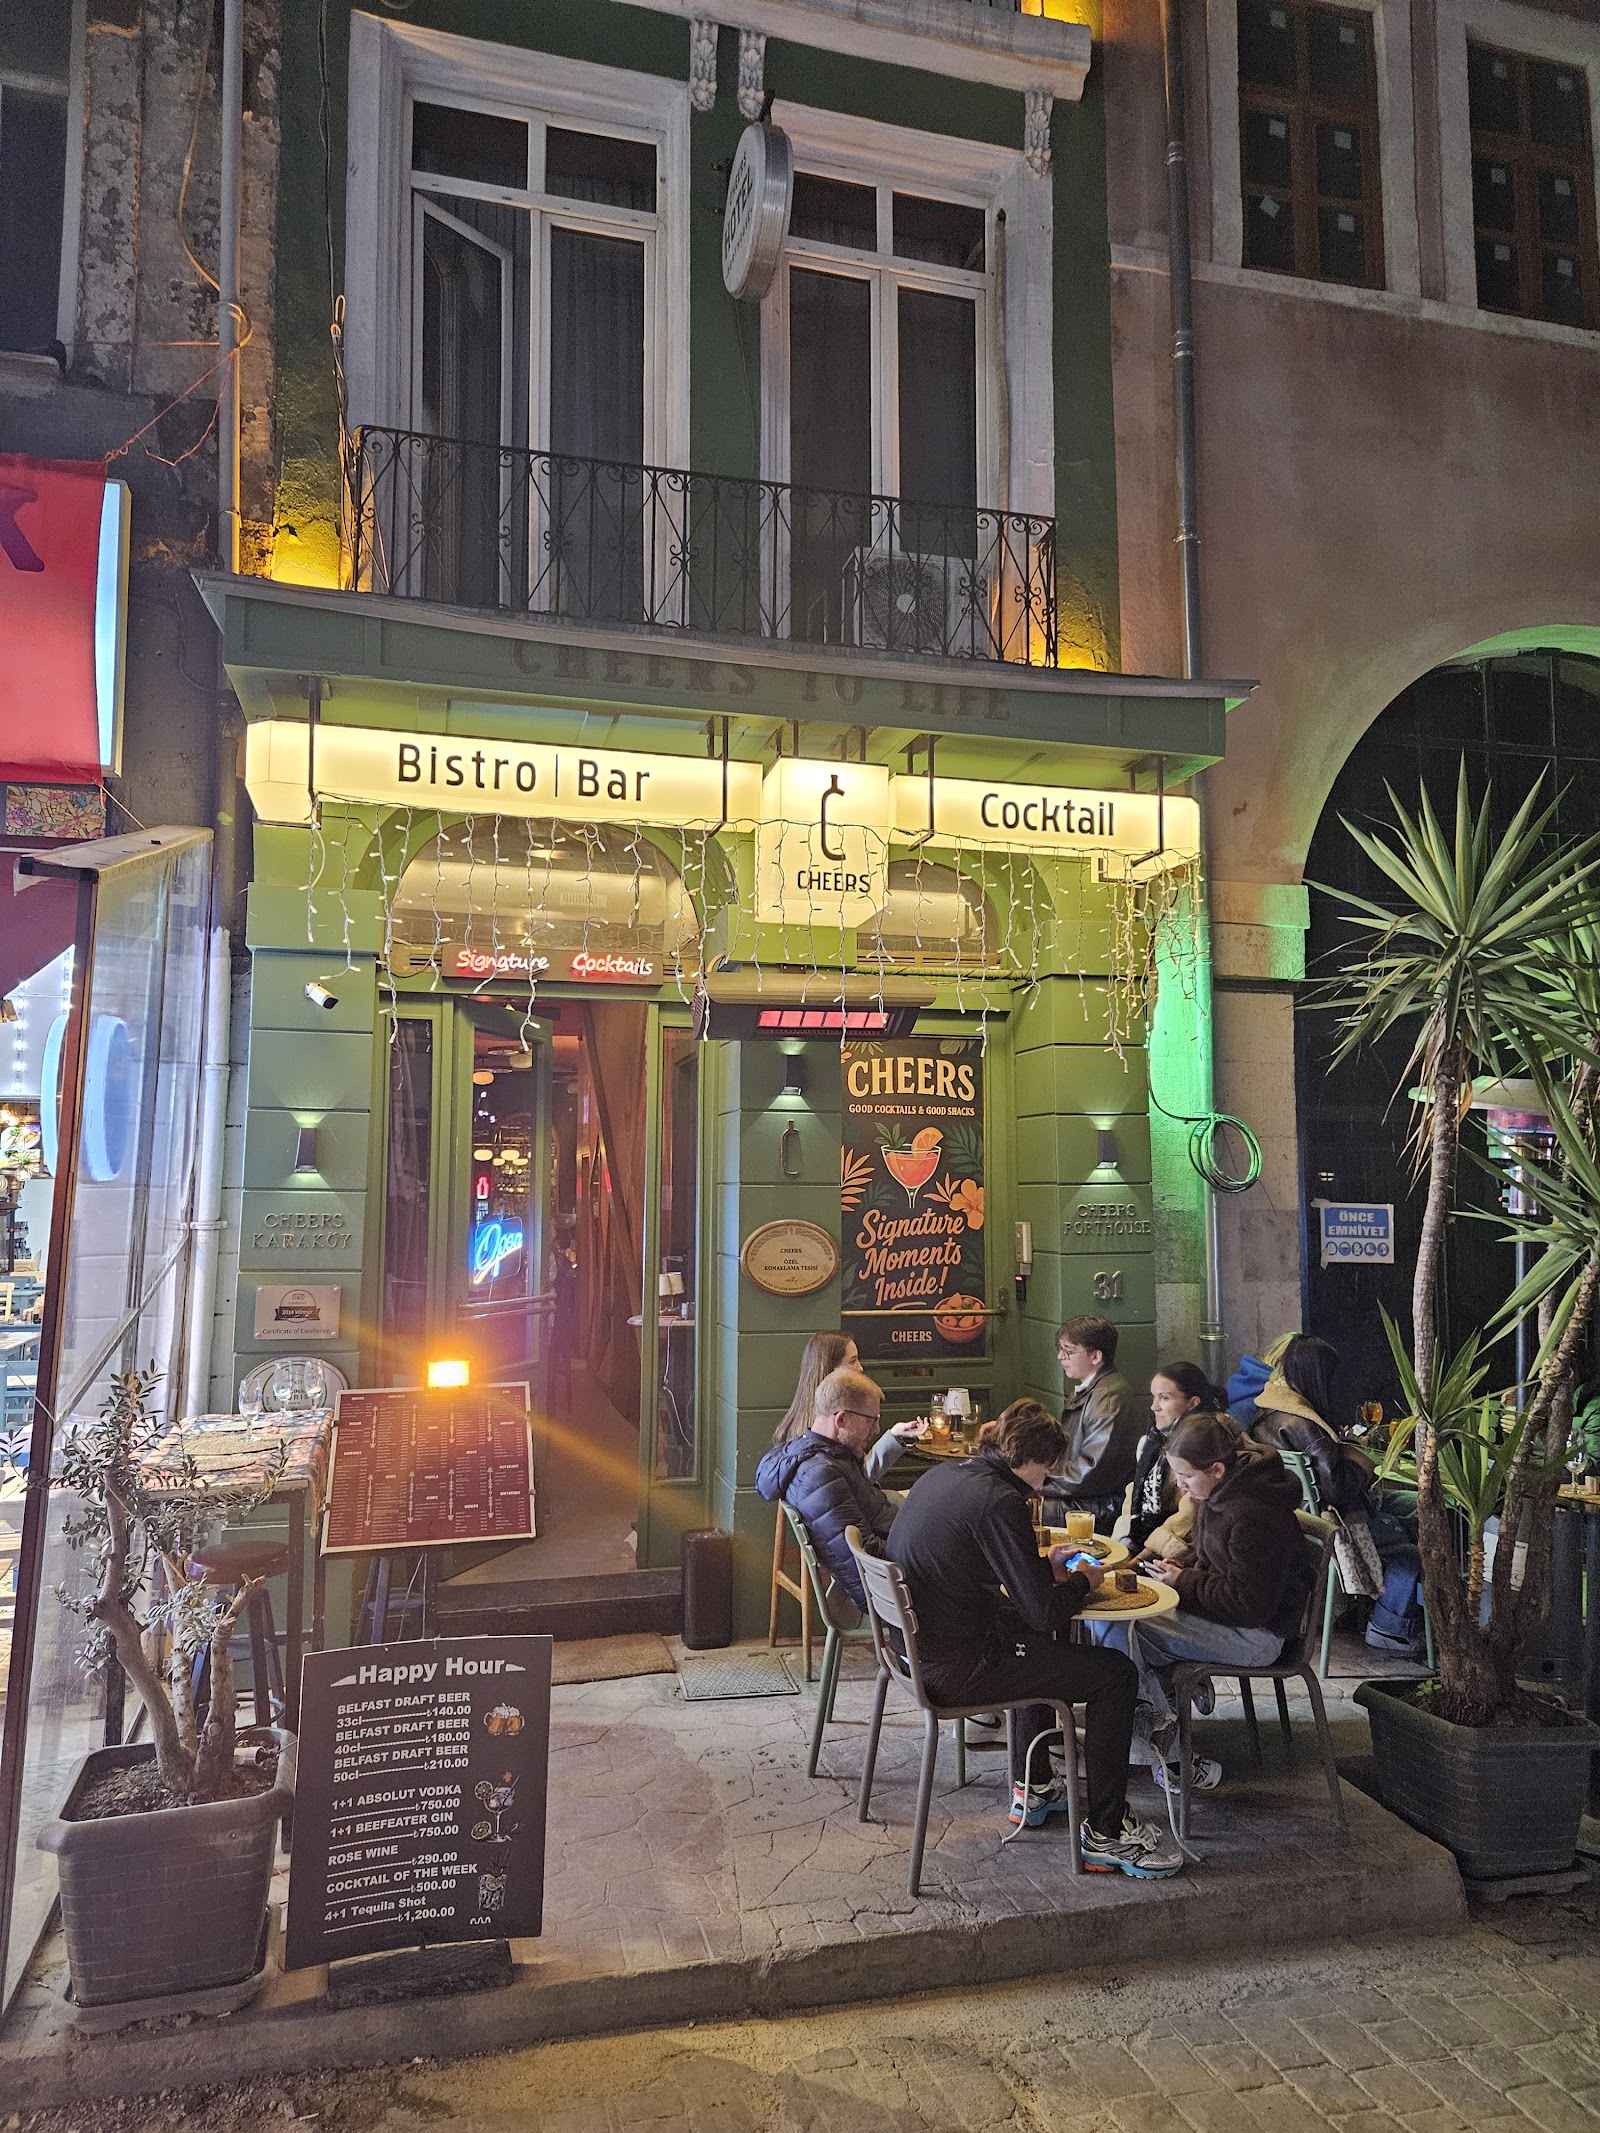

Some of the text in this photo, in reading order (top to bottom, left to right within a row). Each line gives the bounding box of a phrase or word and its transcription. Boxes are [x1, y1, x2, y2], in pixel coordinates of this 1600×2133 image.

[723, 167, 754, 259] HOTEL
[397, 743, 651, 802] Bistro Bar
[980, 792, 1116, 838] Cocktail
[797, 869, 872, 894] CHEERS
[456, 949, 654, 976] Signature Cocktails
[847, 1056, 976, 1102] CHEERS
[849, 1103, 873, 1114] GOOD
[874, 1104, 917, 1115] COCKTAILS
[918, 1105, 925, 1115] &
[926, 1106, 947, 1116] GOOD
[264, 1212, 344, 1229] CHEERS
[1077, 1203, 1136, 1217] CHEERS
[1338, 1210, 1375, 1223] ÖNCE
[251, 1231, 352, 1249] KARAKÖY
[855, 1207, 966, 1249] Signature
[1063, 1220, 1152, 1236] PORTHOUSE
[1327, 1224, 1386, 1237] EMNİYET
[474, 1222, 524, 1278] Open
[858, 1236, 962, 1280] Moments
[874, 1266, 949, 1306] Inside!
[1092, 1270, 1124, 1300] 31
[891, 1330, 933, 1342] CHEERS
[359, 1656, 505, 1685] Happy Hour
[338, 1692, 470, 1715] BELFAST DRAFT BEER
[336, 1719, 469, 1742] BELFAST DRAFT BEER
[334, 1745, 468, 1769] BELFAST DRAFT BEER
[332, 1785, 462, 1810] 1+1 ABSOLUT VODKA
[330, 1812, 453, 1838] 1+1 BEEFEATER GIN
[328, 1845, 399, 1866] ROSE WINE
[326, 1864, 478, 1893] COCKTAIL OF THE WEEK
[324, 1896, 426, 1921] 4+1 Tequila Shot
